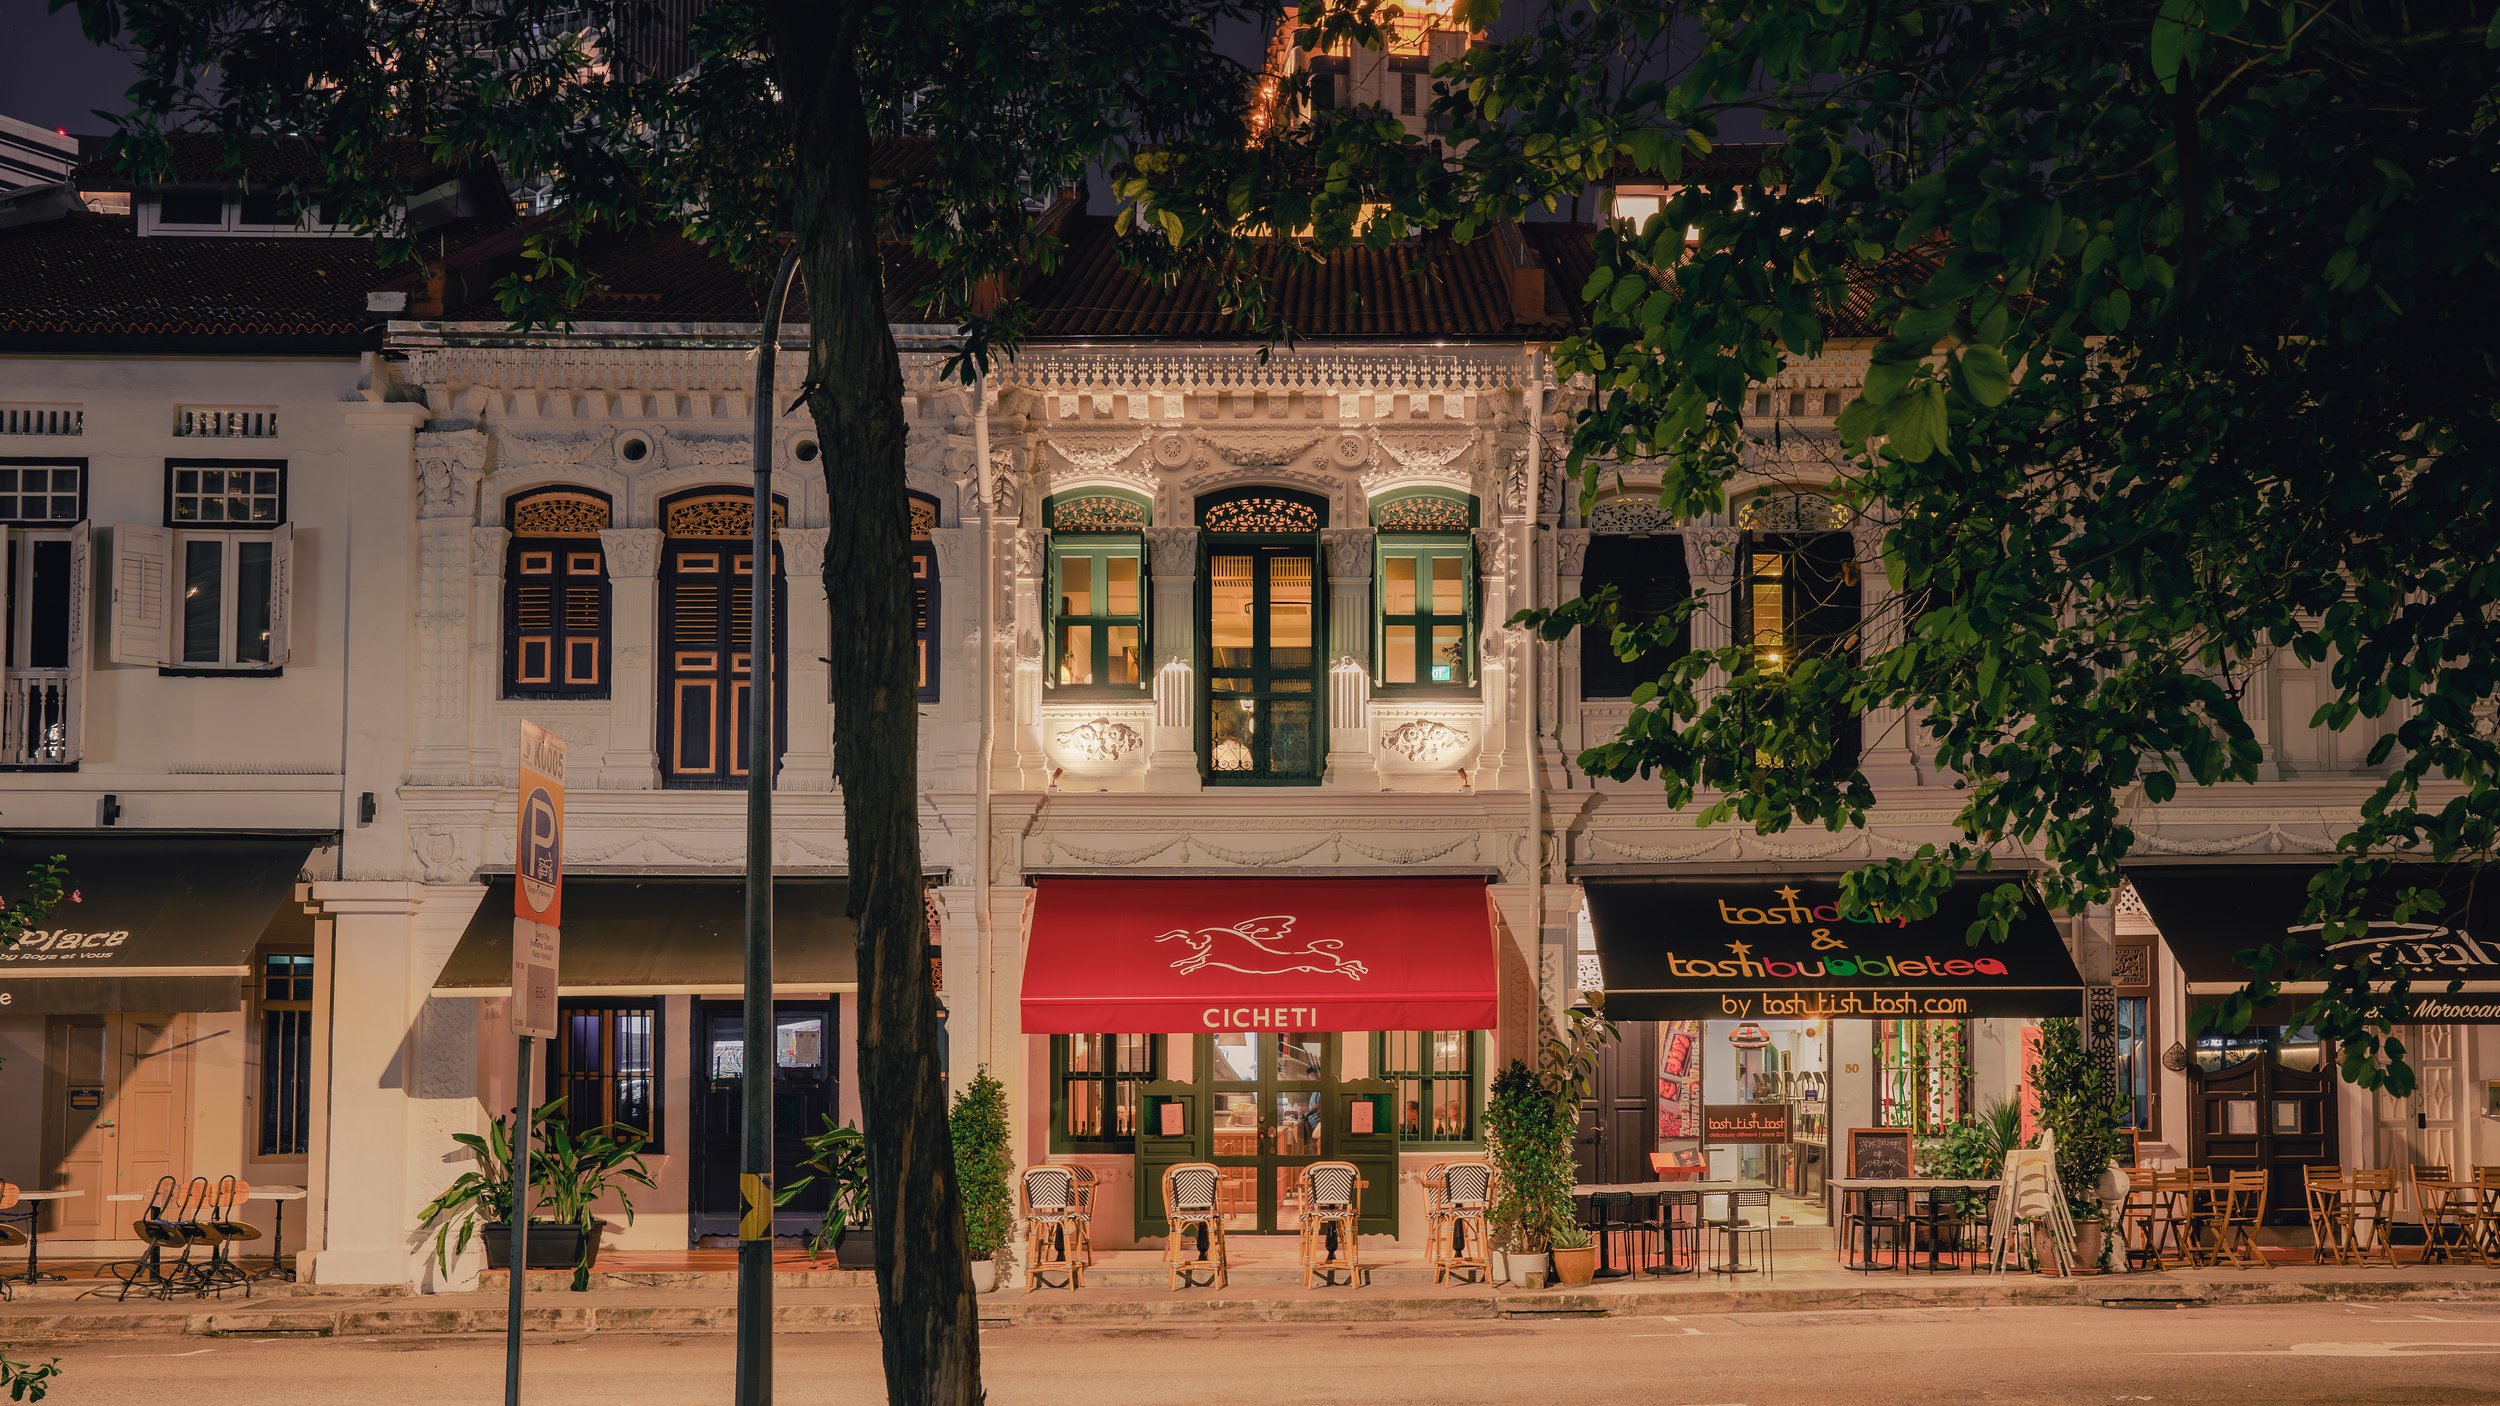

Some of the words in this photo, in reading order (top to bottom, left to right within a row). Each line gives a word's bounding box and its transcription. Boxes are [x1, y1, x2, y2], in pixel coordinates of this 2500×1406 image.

[529, 797, 555, 877] P
[1811, 928, 1848, 950] &
[1722, 994, 1751, 1019] by
[1203, 1008, 1316, 1028] CICHETI
[1845, 1064, 1859, 1073] 50
